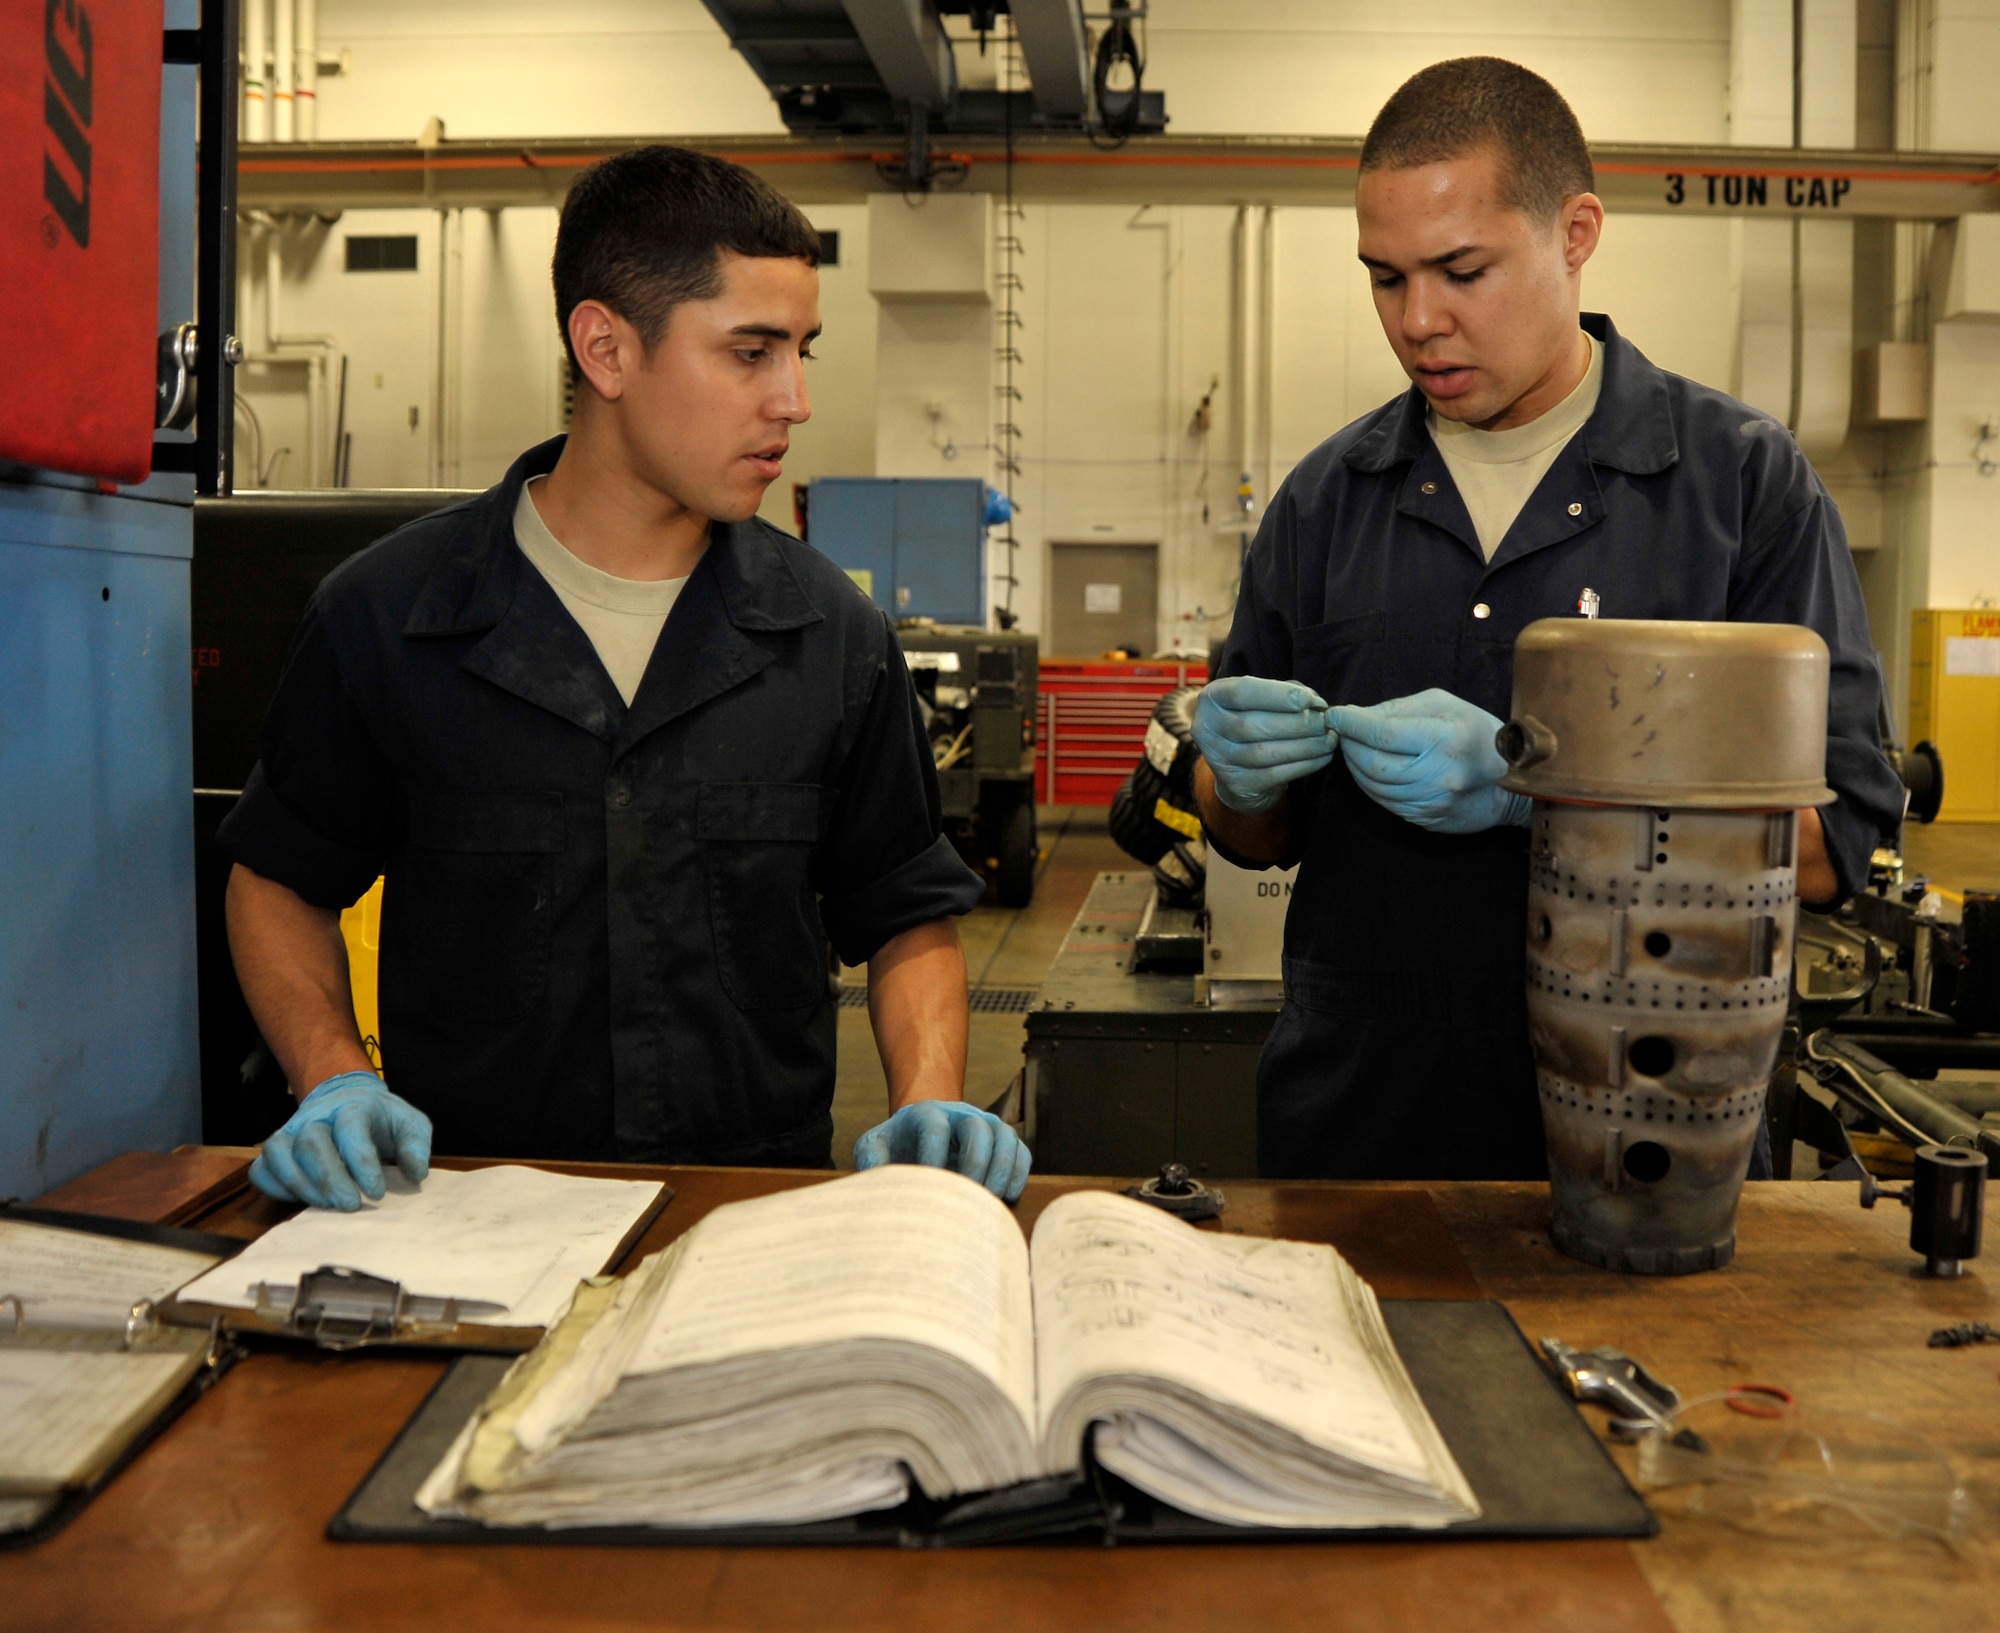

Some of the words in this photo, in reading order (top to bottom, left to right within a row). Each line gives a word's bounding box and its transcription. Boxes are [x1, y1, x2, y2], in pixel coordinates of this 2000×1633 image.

[1665, 173, 1685, 205] 3
[1702, 174, 1767, 206] TON
[1785, 176, 1850, 207] CAP
[1962, 614, 2000, 628] FLAM
[1258, 882, 1280, 897] DO
